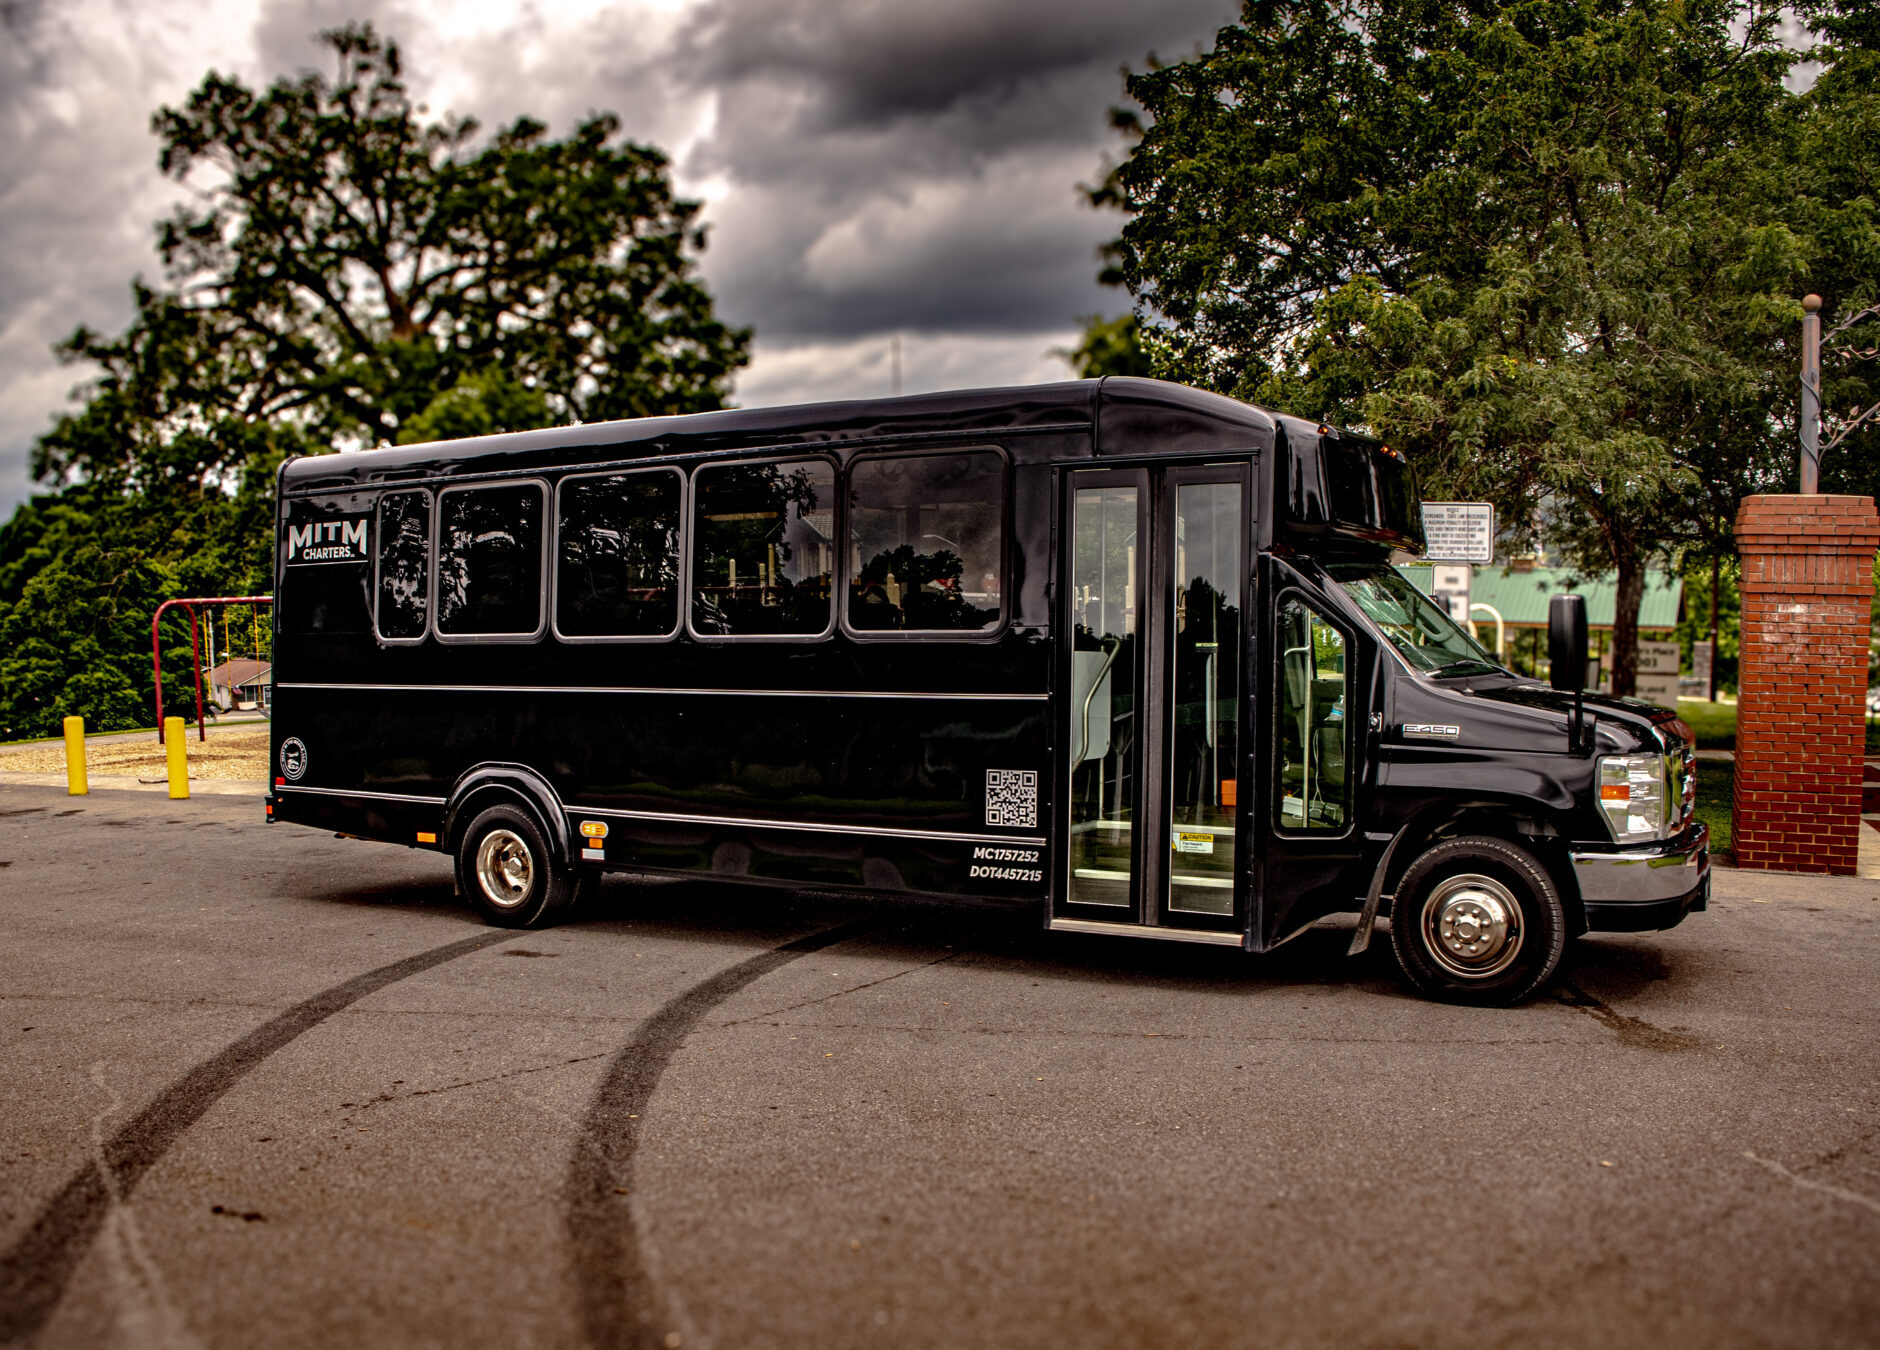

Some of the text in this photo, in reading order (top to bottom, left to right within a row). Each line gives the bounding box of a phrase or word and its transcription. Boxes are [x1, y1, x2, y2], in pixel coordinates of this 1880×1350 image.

[289, 519, 367, 560] MITM
[303, 546, 350, 560] CHARTERS
[973, 847, 1039, 862] MC1757252
[969, 865, 1042, 882] DOT4457215
